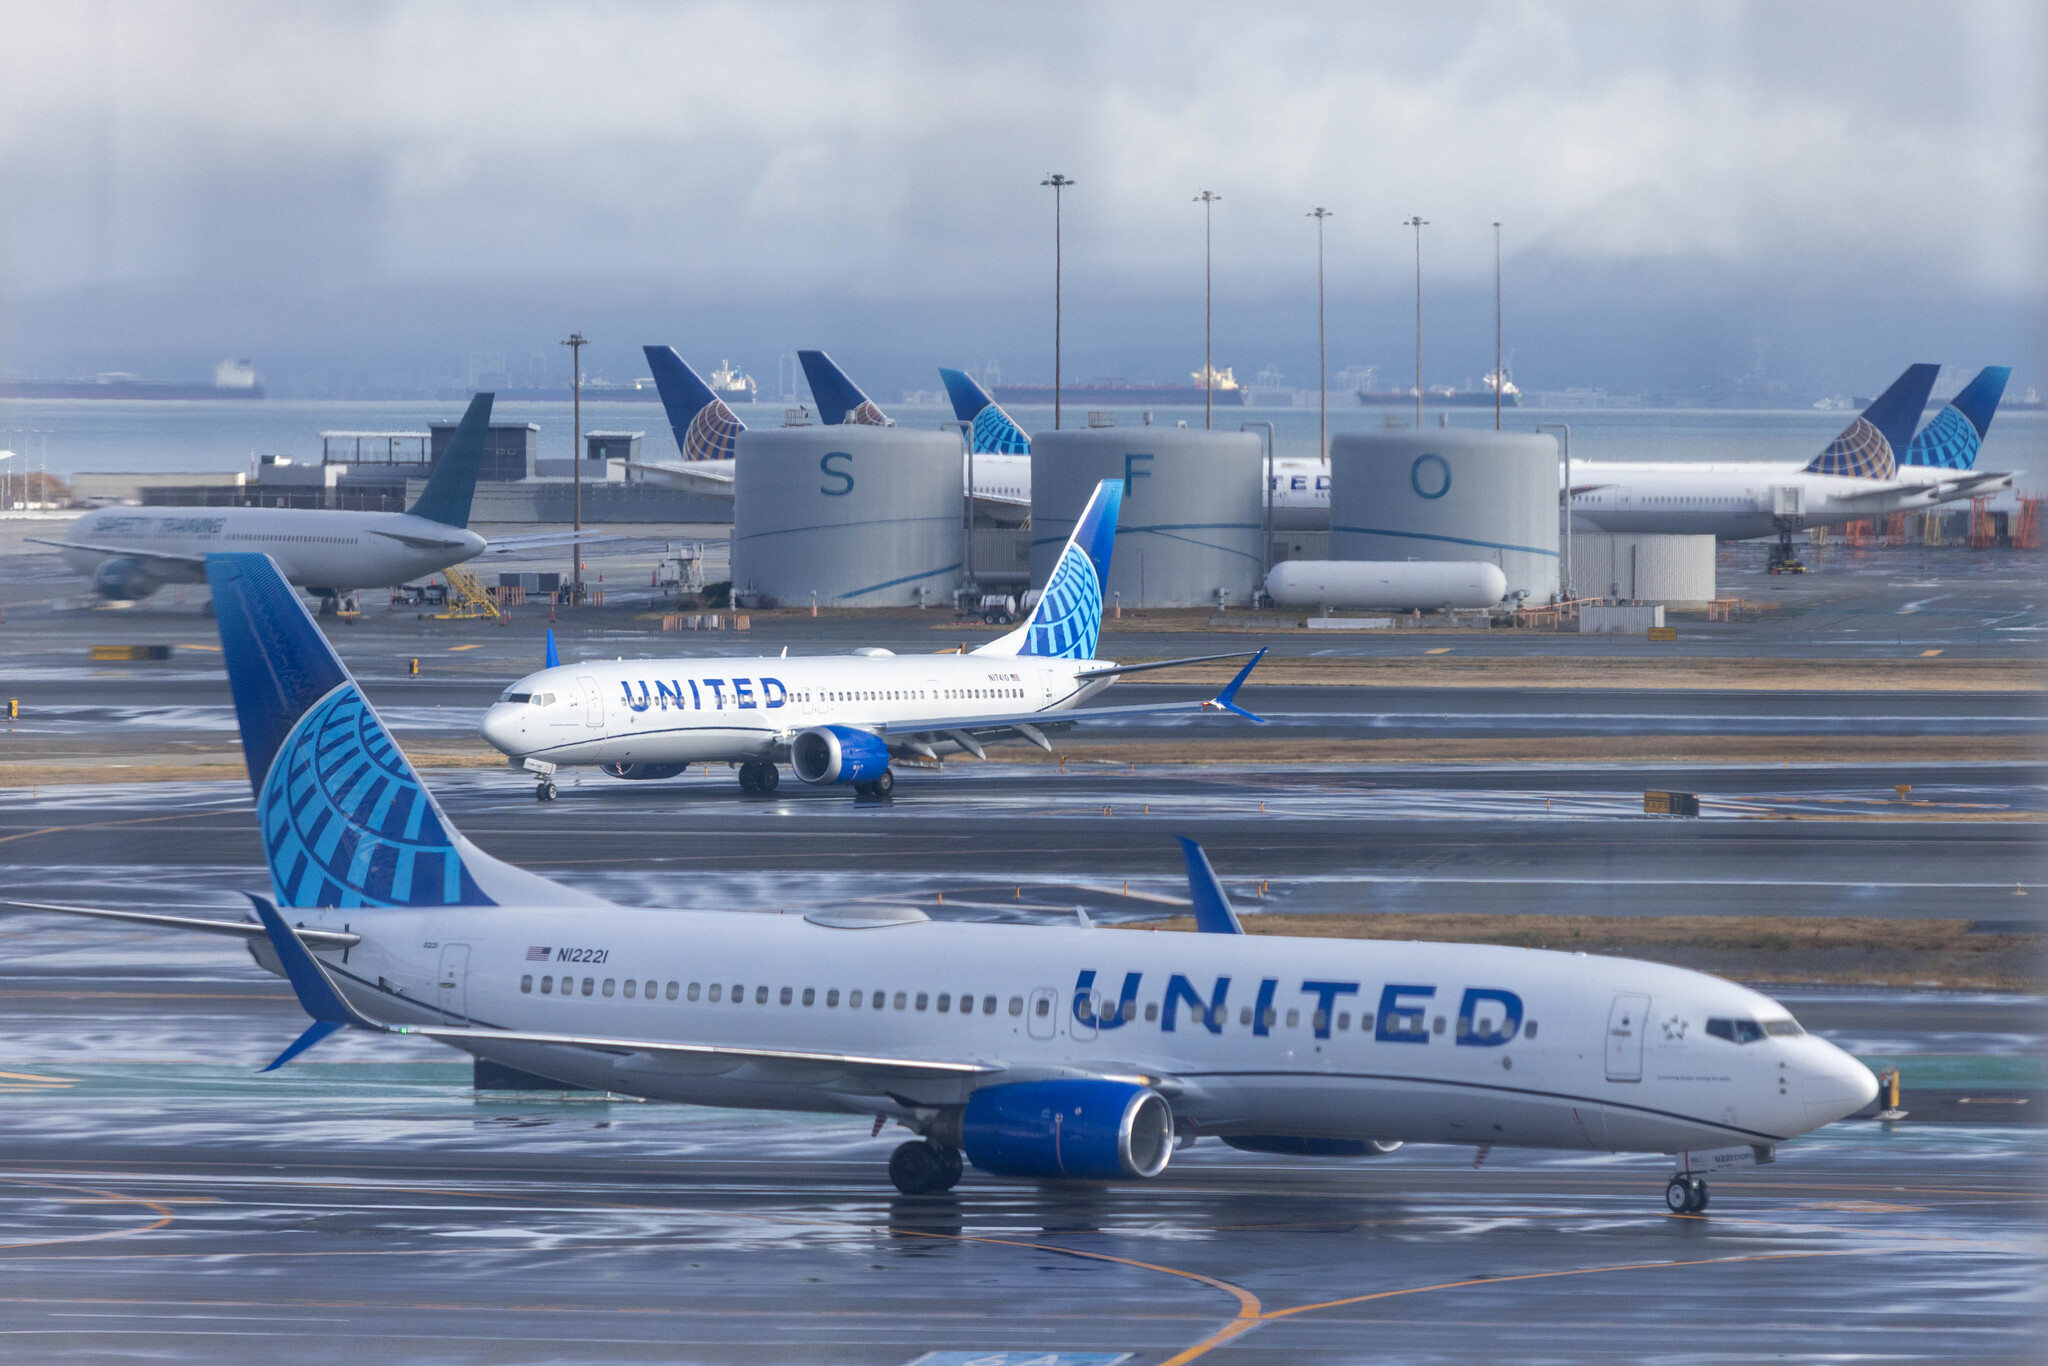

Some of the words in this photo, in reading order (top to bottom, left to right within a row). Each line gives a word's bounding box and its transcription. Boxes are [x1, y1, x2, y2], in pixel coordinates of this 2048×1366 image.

[820, 452, 854, 497] S
[1125, 454, 1154, 498] F
[1411, 453, 1452, 499] O
[620, 677, 787, 712] UNITED
[556, 948, 609, 964] N12221
[1072, 969, 1525, 1047] UNITED
